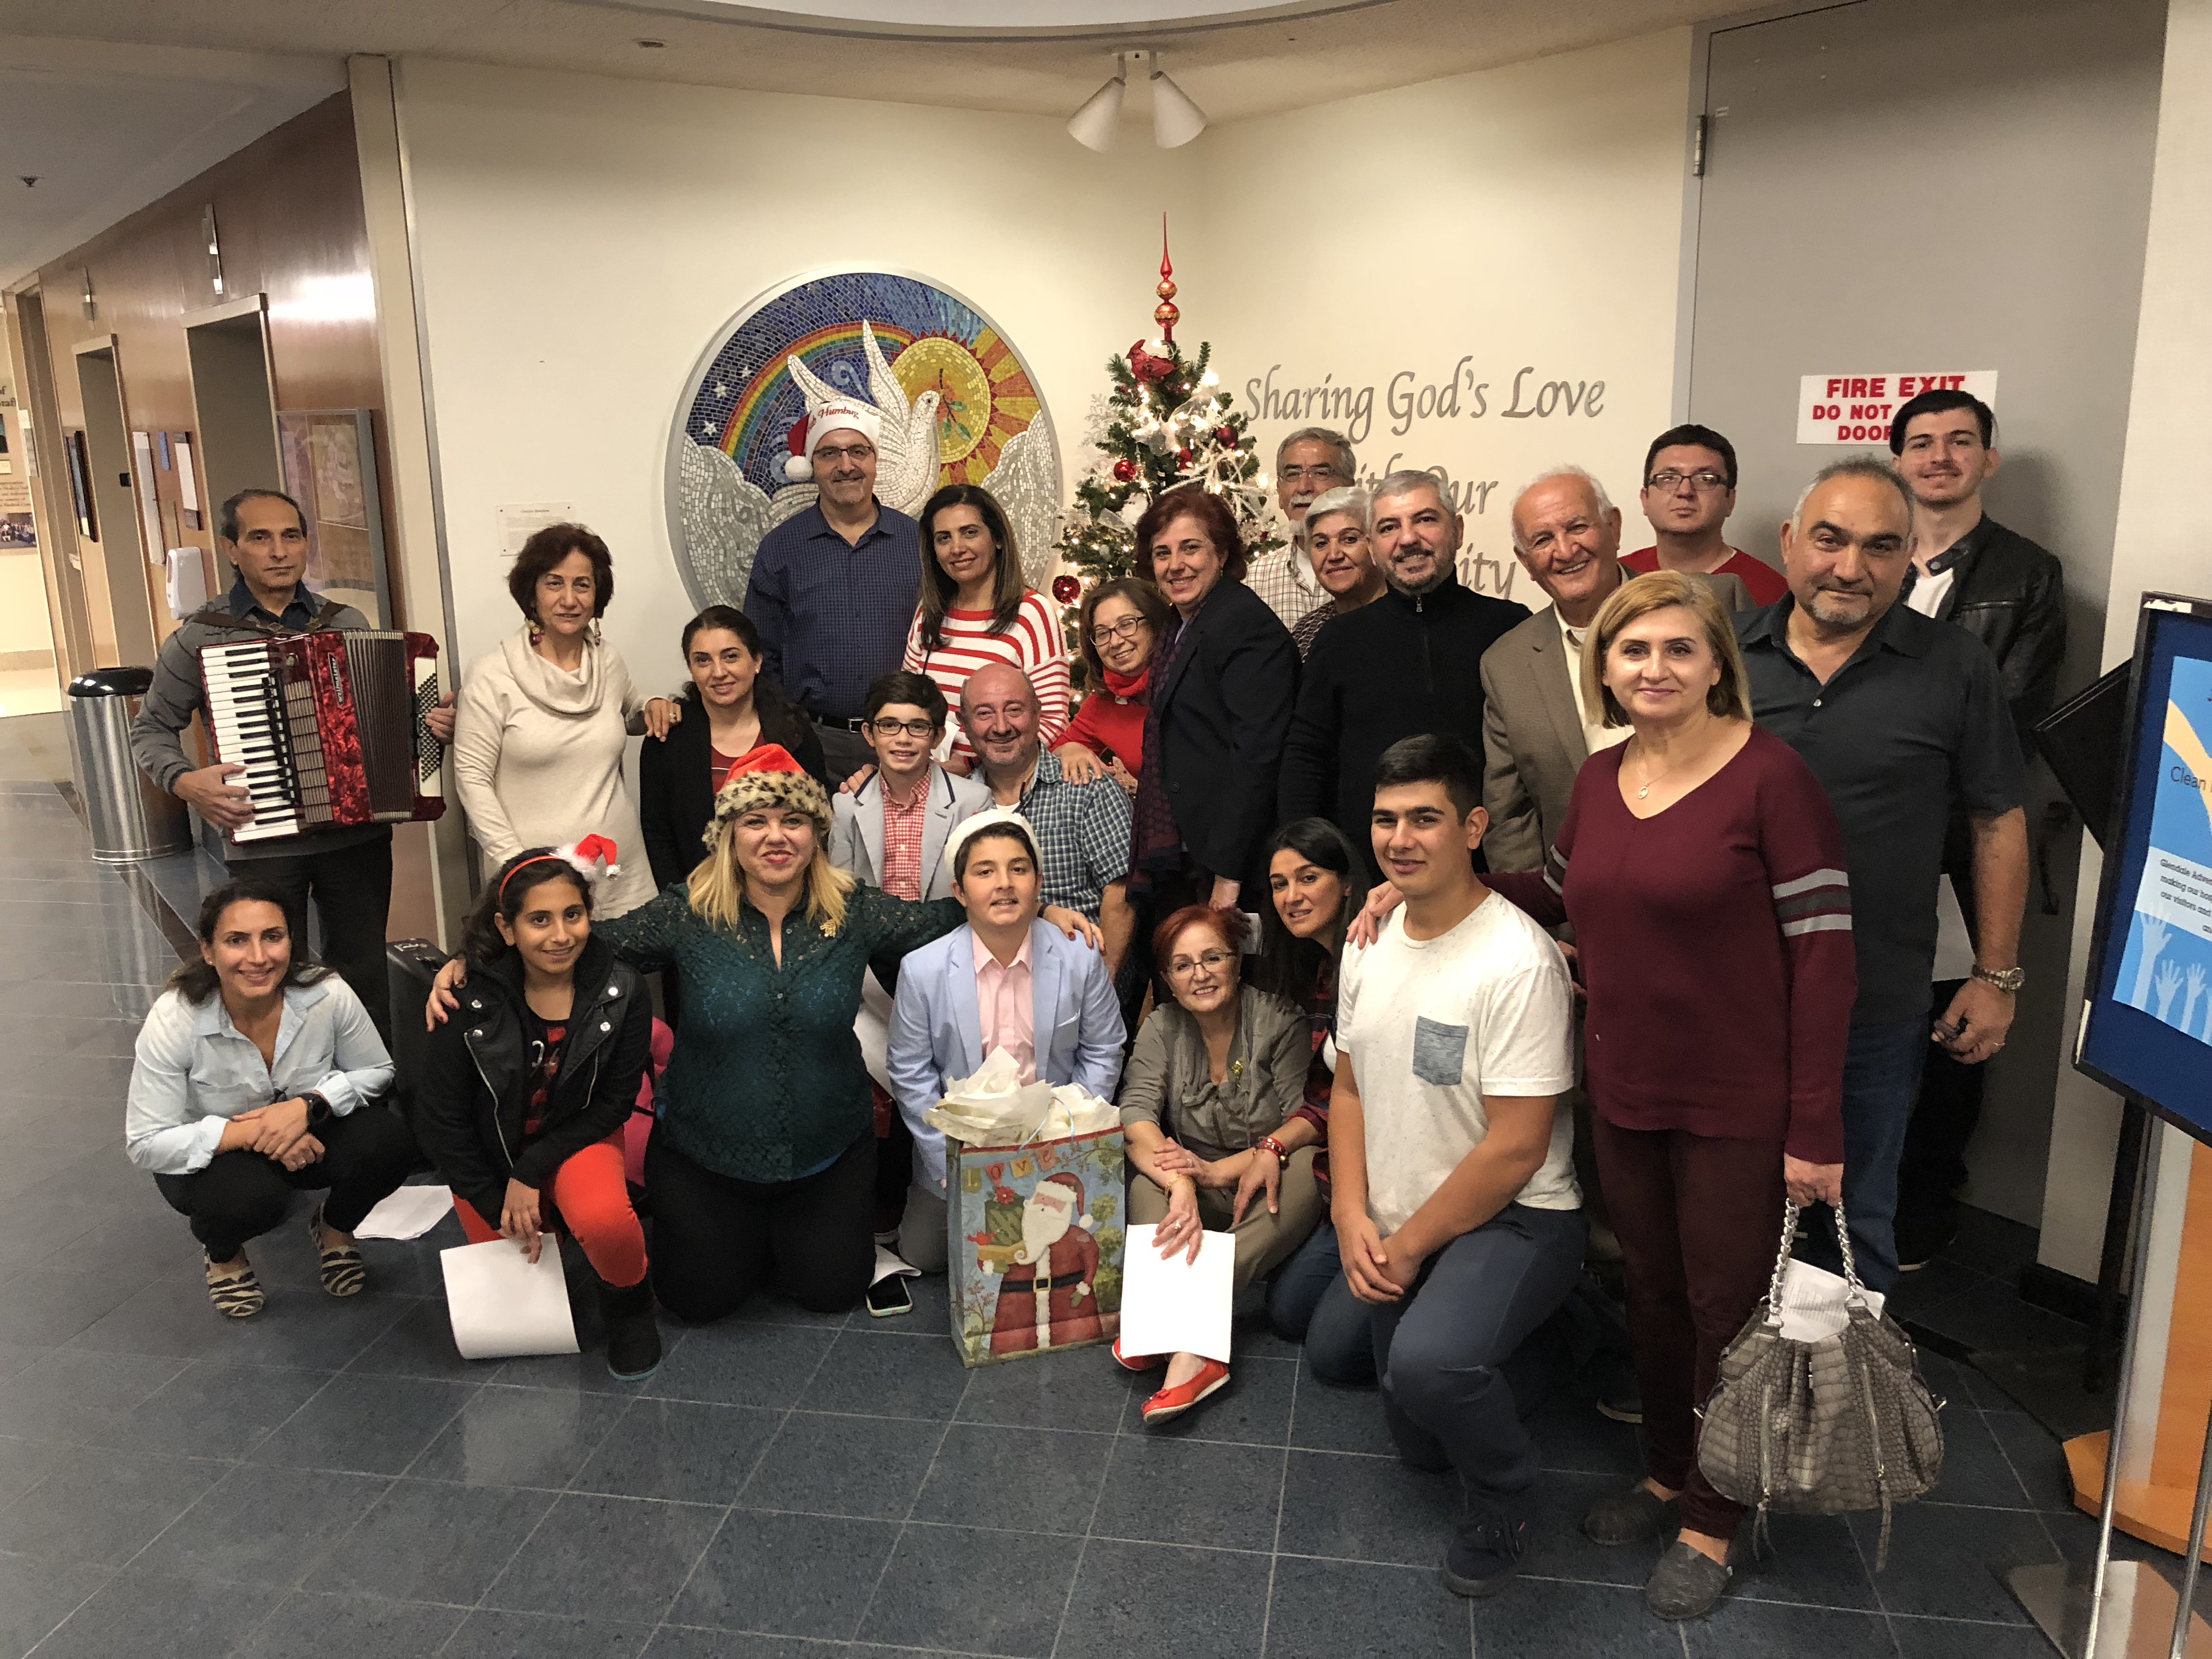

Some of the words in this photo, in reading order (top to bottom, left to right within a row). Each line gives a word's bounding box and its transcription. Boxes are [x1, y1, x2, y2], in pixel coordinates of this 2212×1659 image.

[1826, 378, 1886, 398] FIRE
[1898, 375, 1966, 397] EXIT
[1243, 364, 1374, 444] Sharing
[1387, 355, 1489, 436] God's
[1500, 366, 1605, 418] Love
[817, 404, 859, 420] Humbug
[1813, 405, 1841, 420] DO
[1850, 404, 1892, 420] NOT
[2170, 766, 2207, 791] Clean
[2160, 859, 2191, 877] Glendale
[2160, 876, 2187, 892] making
[2187, 887, 2199, 895] our
[2160, 891, 2172, 900] our
[2173, 896, 2197, 911] visitors
[2197, 906, 2211, 917] and
